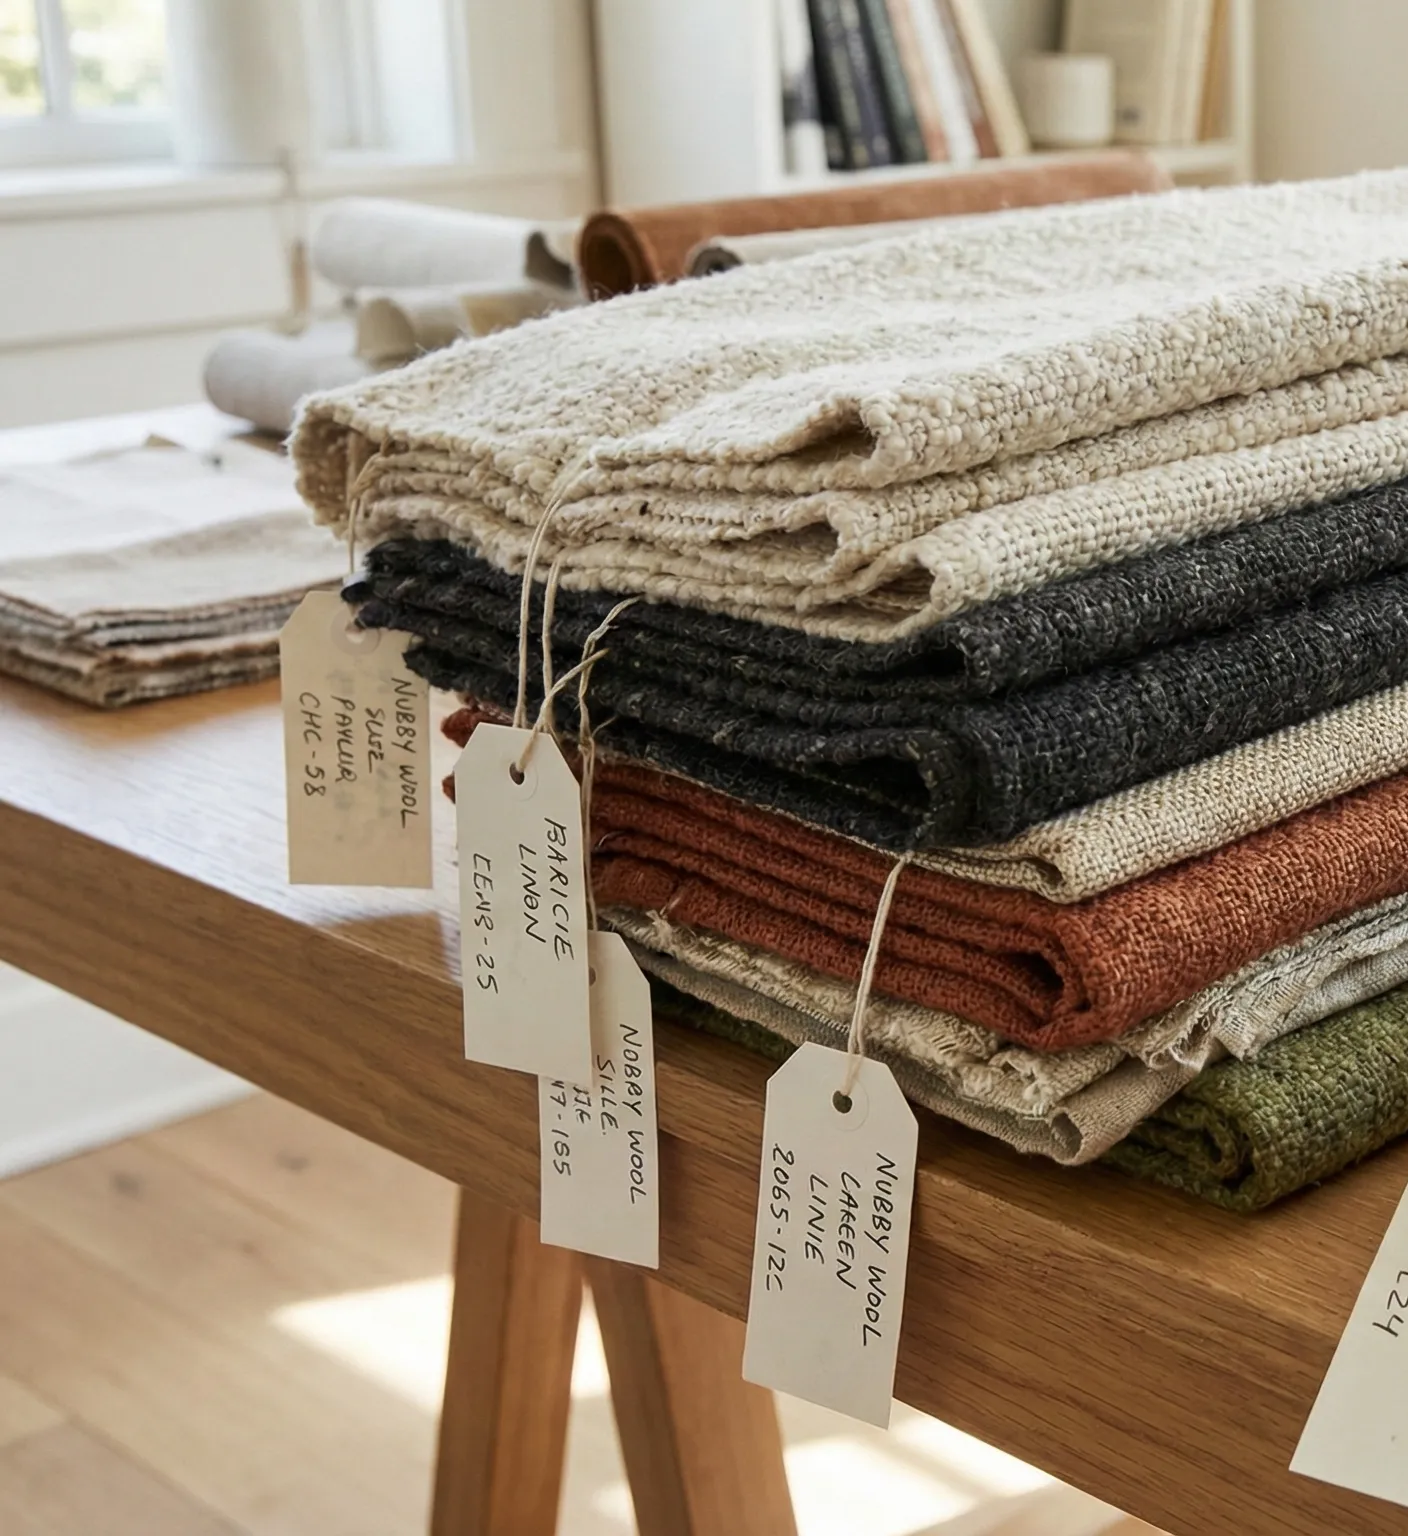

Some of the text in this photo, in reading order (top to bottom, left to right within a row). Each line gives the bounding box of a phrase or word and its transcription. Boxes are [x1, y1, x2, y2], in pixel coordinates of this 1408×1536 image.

[391, 677, 419, 829] NUBBY WOOL
[627, 1129, 647, 1204] WOOL
[804, 1173, 829, 1265] LINIE
[862, 1152, 899, 1347] NUBBY WOOL
